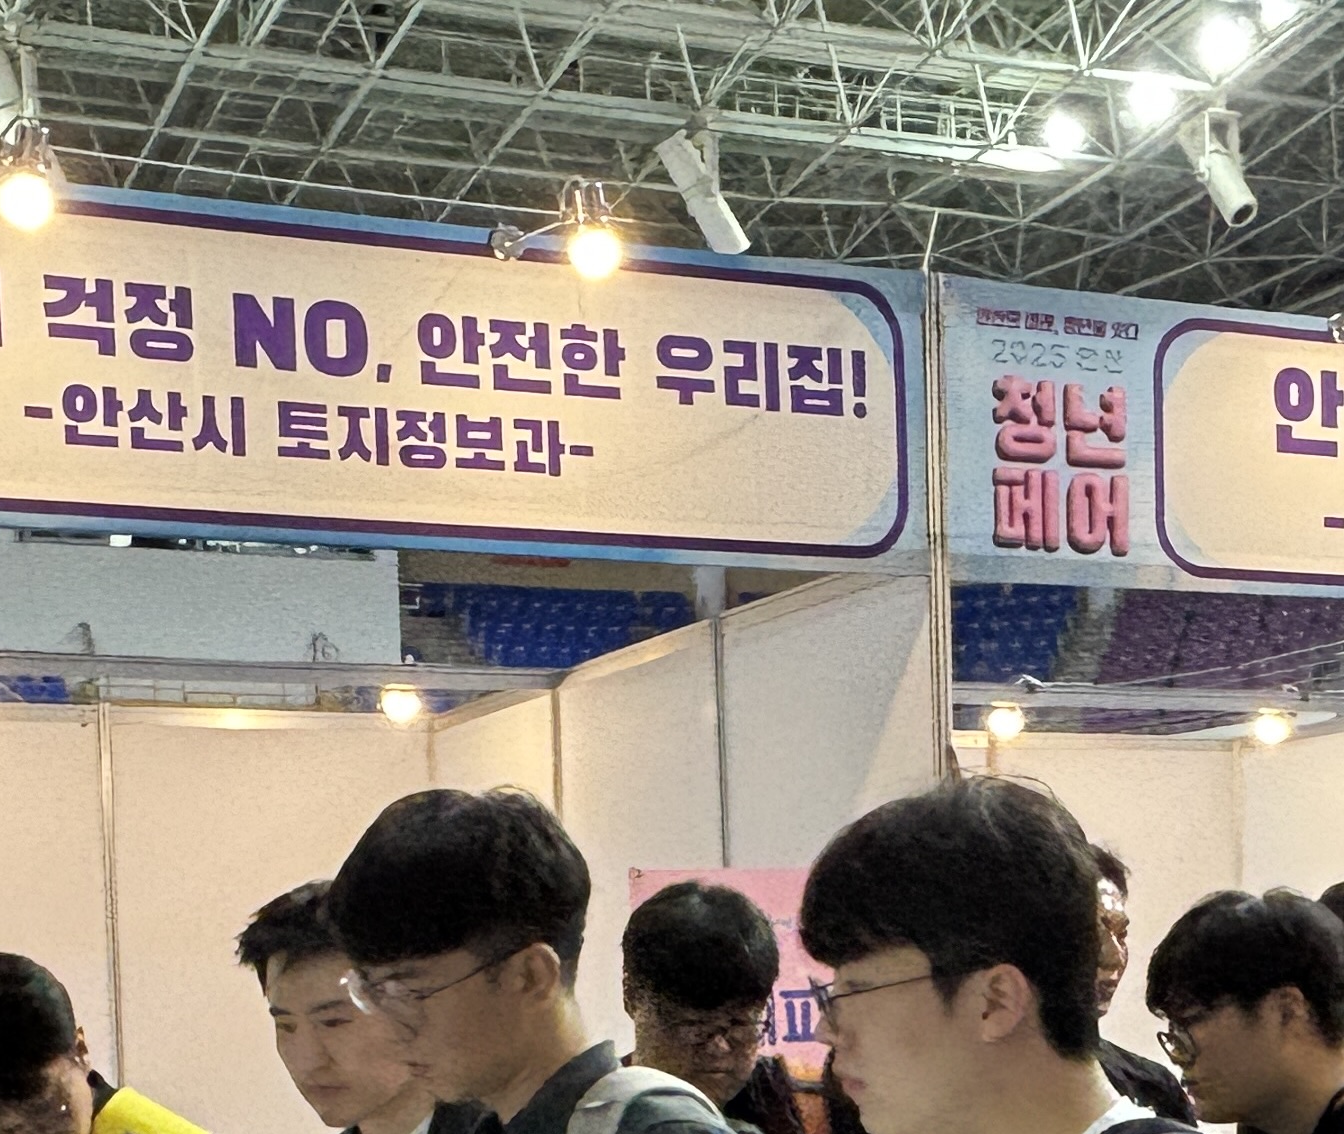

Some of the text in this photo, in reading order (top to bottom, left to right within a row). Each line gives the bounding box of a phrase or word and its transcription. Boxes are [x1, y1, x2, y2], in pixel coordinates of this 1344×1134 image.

[43, 274, 193, 361] 걱정
[233, 294, 390, 383] NO,
[418, 313, 626, 399] 안전한
[656, 334, 867, 418] 우리집!
[24, 384, 594, 477] -안산시 토지정보과-
[992, 374, 1127, 468] 청년
[992, 466, 1129, 557] 페어
